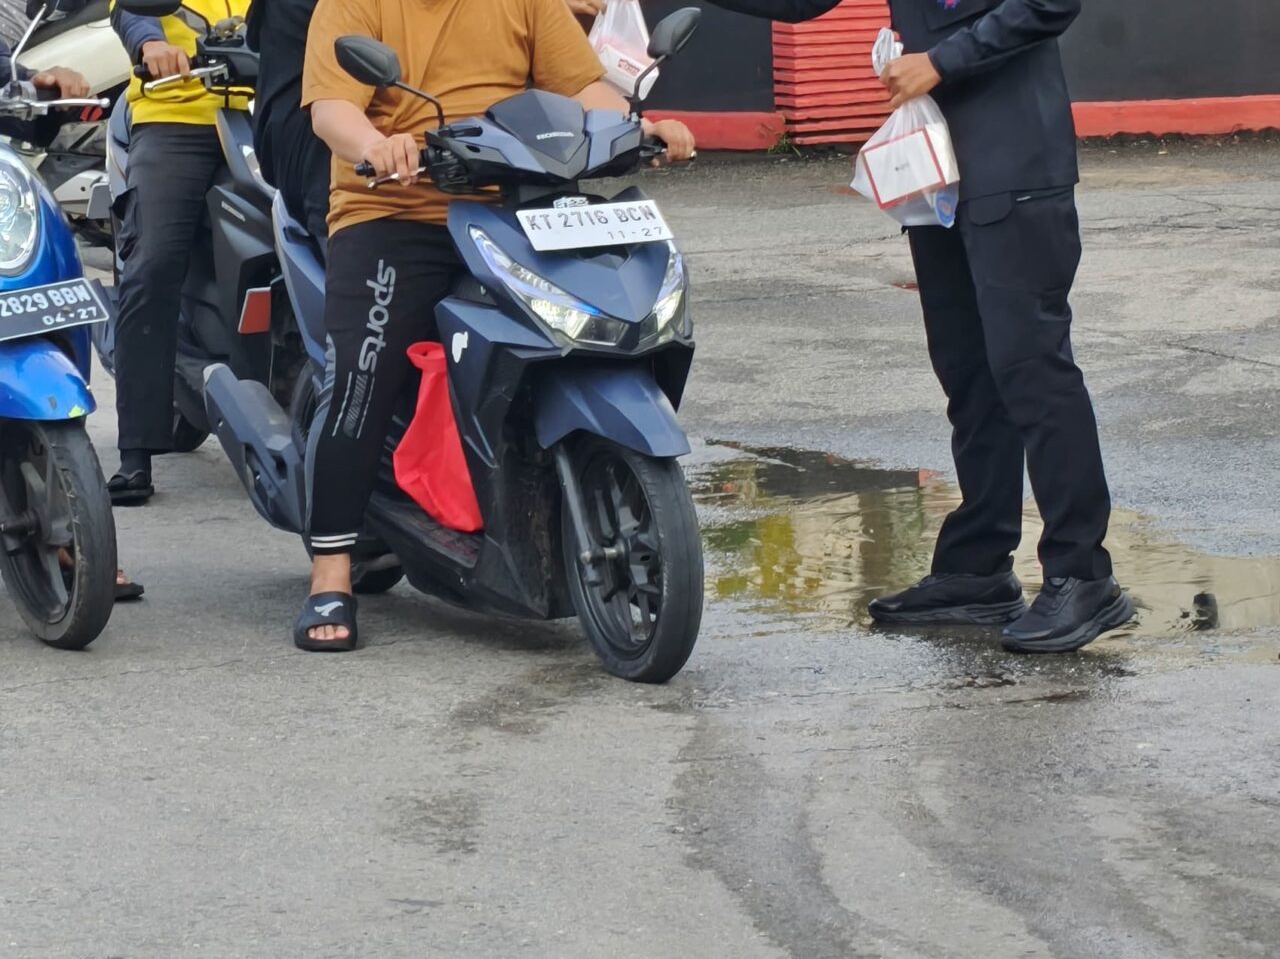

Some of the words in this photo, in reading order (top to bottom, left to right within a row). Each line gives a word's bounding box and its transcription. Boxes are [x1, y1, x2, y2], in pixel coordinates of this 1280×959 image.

[525, 212, 553, 231] KT
[558, 210, 609, 228] 2716
[613, 205, 656, 223] BCN
[49, 284, 92, 308] BBN
[358, 259, 396, 374] sports
